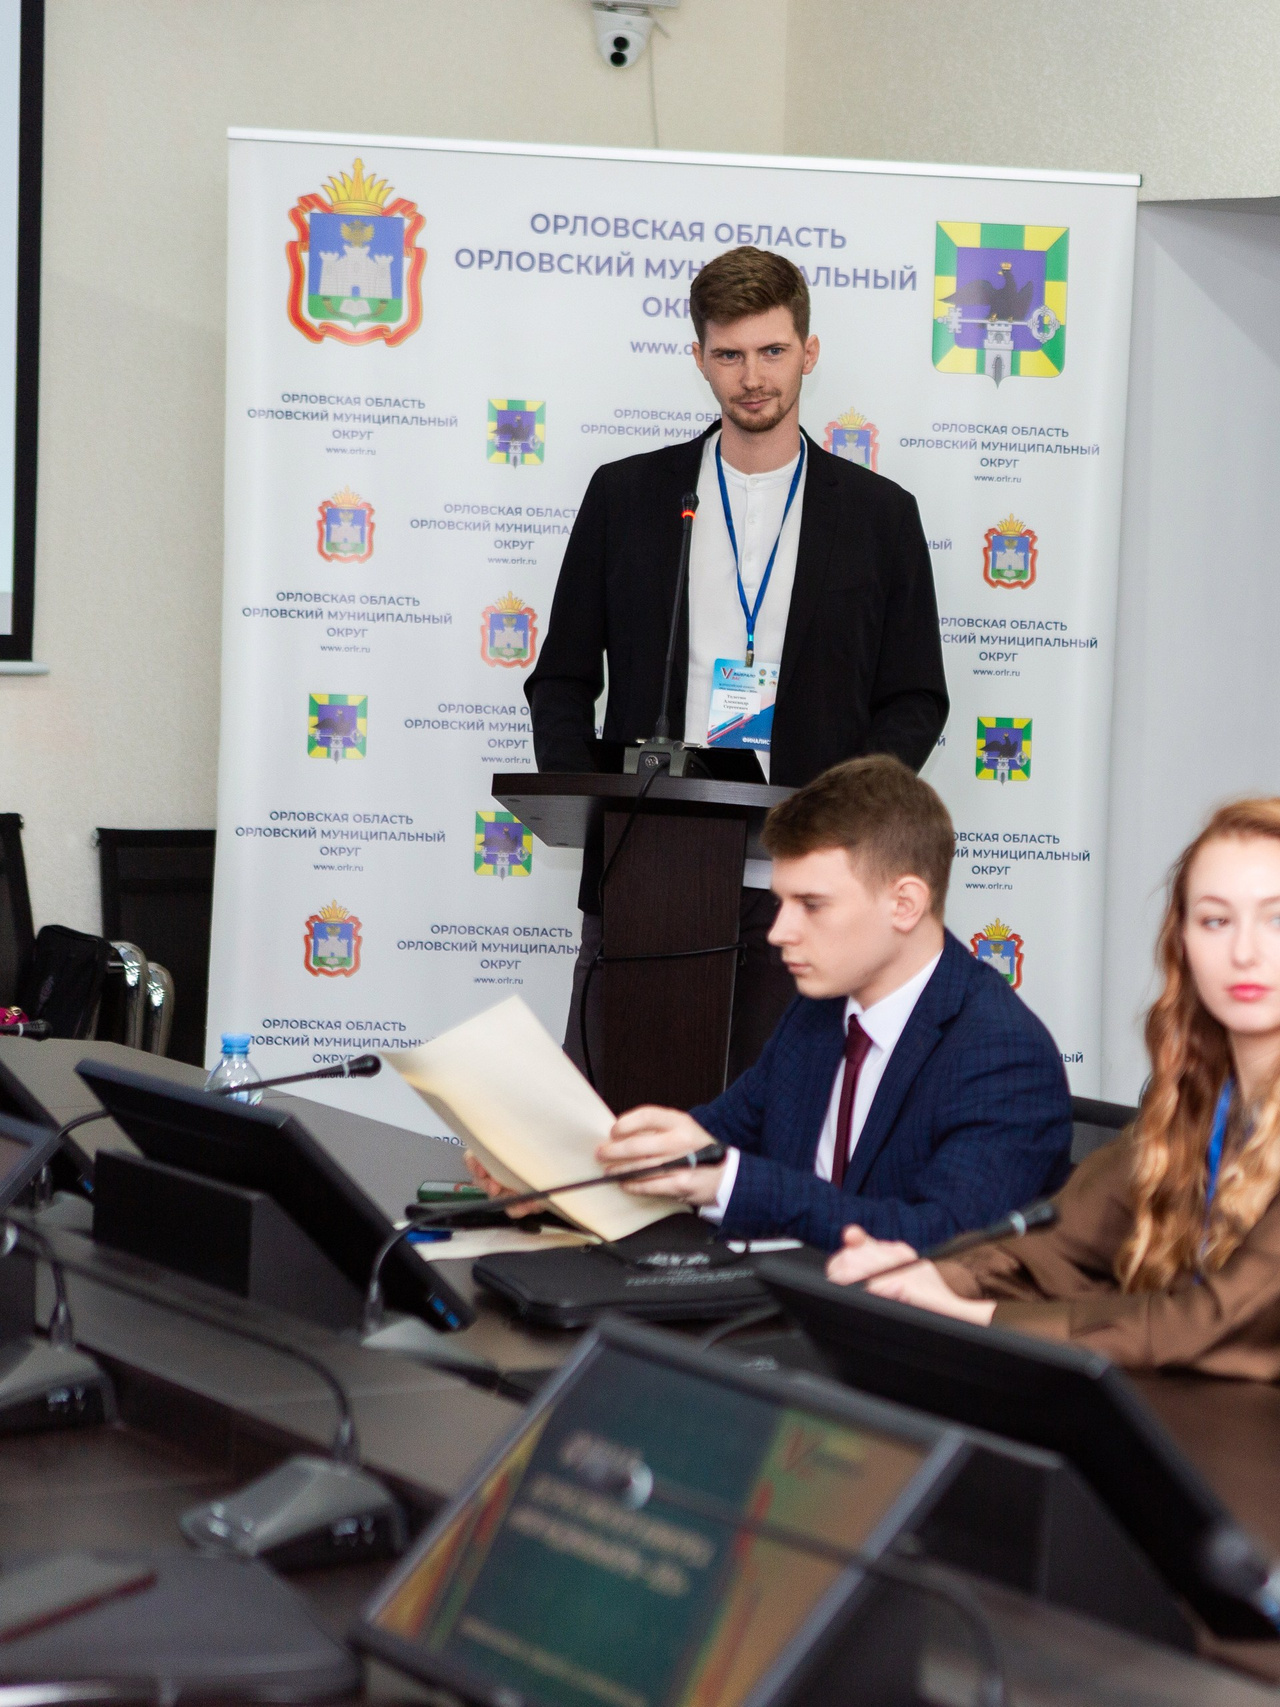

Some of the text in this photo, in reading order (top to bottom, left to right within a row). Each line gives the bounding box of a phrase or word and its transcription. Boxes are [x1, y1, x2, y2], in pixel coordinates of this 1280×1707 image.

[530, 213, 846, 249] ОРЛОВСКАЯ ОБЛАСТЬ
[455, 248, 634, 277] ОРЛОВСКИЙ
[281, 393, 425, 409] ОРЛОВСКАЯ ОБЛАСТЬ
[247, 409, 458, 427] ОРЛОВСКИЙ МУНИЦИПАЛЬНЫЙ
[614, 409, 691, 421] ОРЛОВСКАЯ
[332, 429, 374, 440] ОКРУГ
[581, 424, 660, 437] ОРЛОВСКИЙ
[932, 423, 1069, 437] ОРЛОВСКАЯ ОБЛАСТЬ
[325, 447, 376, 455] www.orlr.ru
[900, 438, 1099, 455] ОРЛОВСКИЙ МУНИЦИПАЛЬНЫЙ
[980, 458, 1019, 468] ОКРУГ
[444, 504, 578, 519] ОРЛОВСКАЯ ОБЛАСТ
[410, 519, 571, 535] ОРЛОВСКИЙ МУНИЦИПА
[494, 540, 535, 550] ОКРУГ
[488, 557, 537, 565] www.orlr.ru
[276, 591, 420, 606] ОРЛОВСКАЯ ОБЛАСТЬ
[242, 608, 452, 624] ОРЛОВСКИЙ МУНИЦИПАЛЬНЫЙ
[939, 617, 1067, 631] РЛОВСКАЯ ОБЛАСТЬ
[326, 626, 368, 638] ОКРУГ
[980, 635, 1097, 648] МУНИЦИПАЛЬНЫЙ
[320, 645, 370, 653] www.orlr.ru
[979, 652, 1018, 661] ОКРУГ
[438, 703, 516, 715] ОРЛОВСКАЯ
[404, 719, 484, 731] ОРЛОВСКИЙ
[488, 739, 529, 749] ОКРУГ
[481, 756, 531, 764] www.orlr.ru
[269, 811, 413, 825] ОРЛОВСКАЯ ОБЛАСТЬ
[235, 827, 445, 842] ОРЛОВСКИЙ МУНИЦИПАЛЬНЫЙ
[953, 832, 1060, 844] ОВСКАЯ ОБЛАСТЬ
[320, 846, 361, 856] ОКРУГ
[973, 849, 1090, 861] МУНИЦИПАЛЬНЫЙ
[972, 865, 1011, 875] ОКРУГ
[431, 925, 573, 938] ОРЛОВСКАЯ ОБЛАСТЬ
[397, 940, 580, 955] ОРЛОВСКИЙ МУНИЦИПАЛЬН
[480, 959, 521, 969] ОКРУГ
[262, 1019, 406, 1031] ОРЛОВСКАЯ ОБЛАСТЬ
